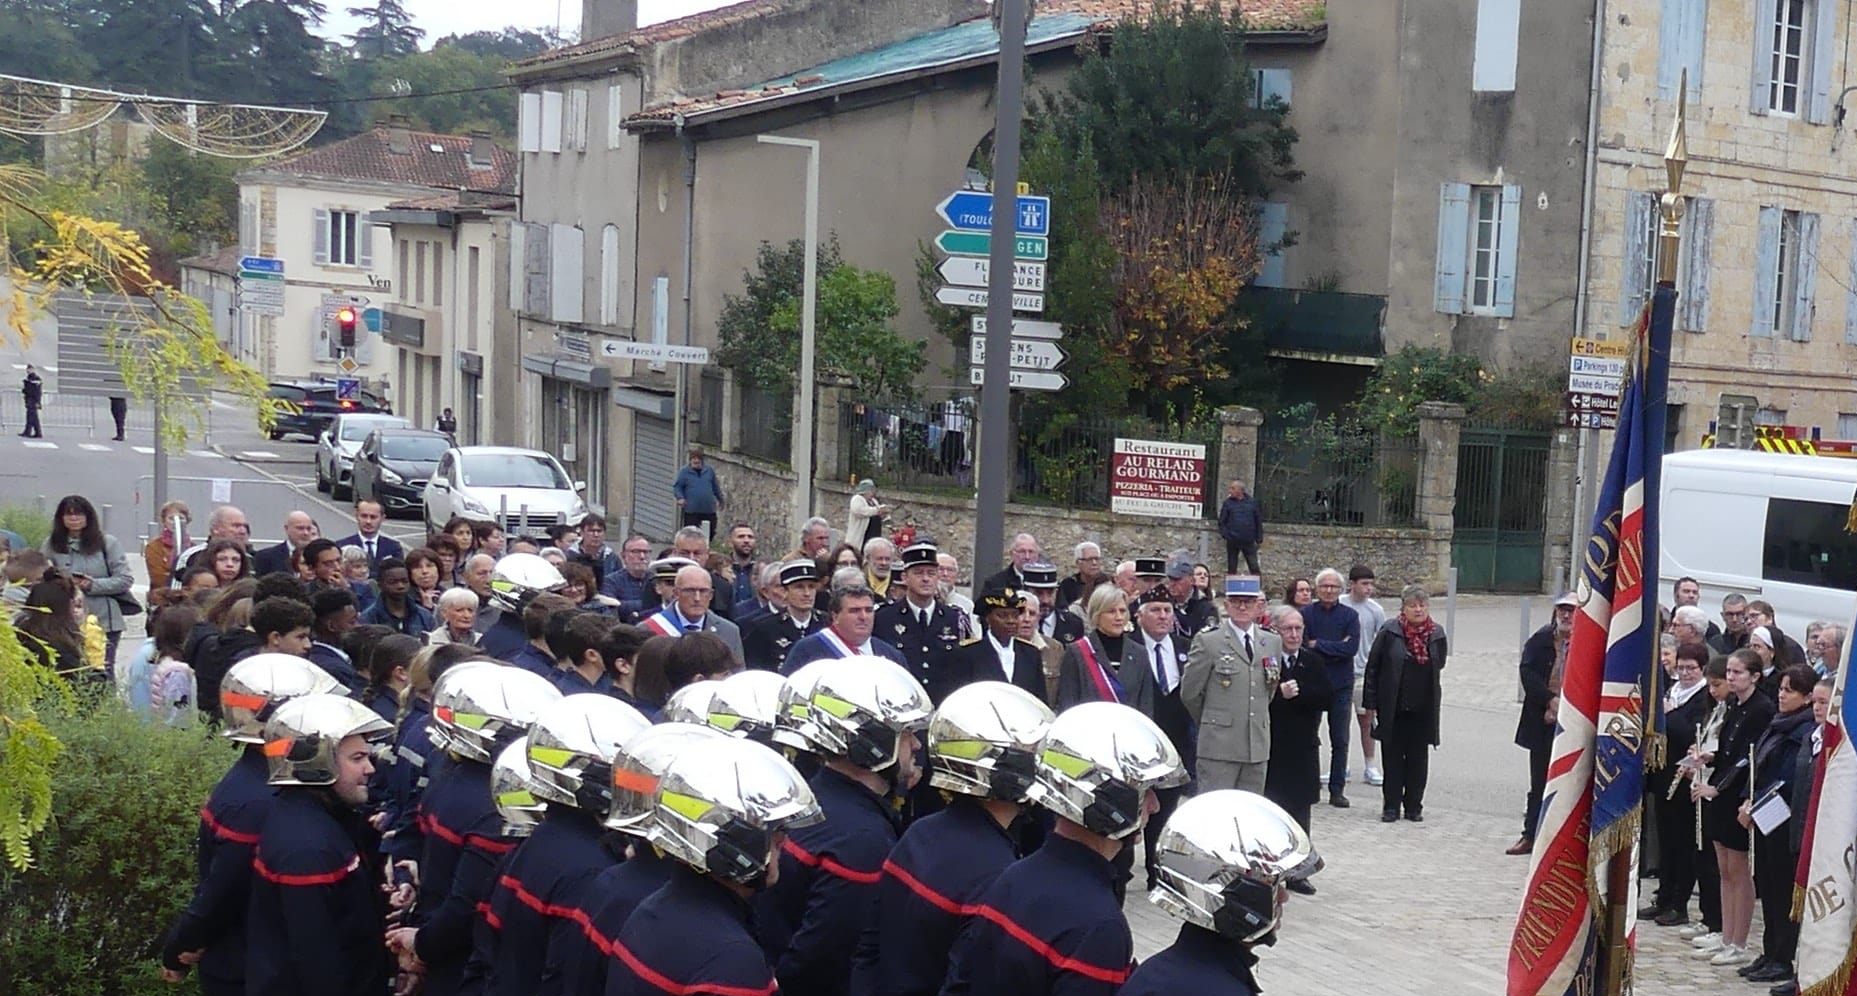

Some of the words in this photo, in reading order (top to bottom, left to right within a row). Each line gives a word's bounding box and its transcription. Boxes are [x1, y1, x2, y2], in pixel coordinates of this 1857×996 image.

[1017, 241, 1042, 254] GEN
[367, 274, 391, 289] Ven
[626, 346, 662, 358] Marché
[669, 349, 706, 361] Couvert
[1124, 441, 1196, 457] Restaurant
[1123, 456, 1141, 467] AU
[1147, 458, 1194, 471] RELAIS
[1116, 466, 1200, 482] GOURMAND
[1115, 482, 1153, 492] PIZZERIA
[1160, 485, 1201, 495] TRAITEUR
[1807, 874, 1845, 923] DE
